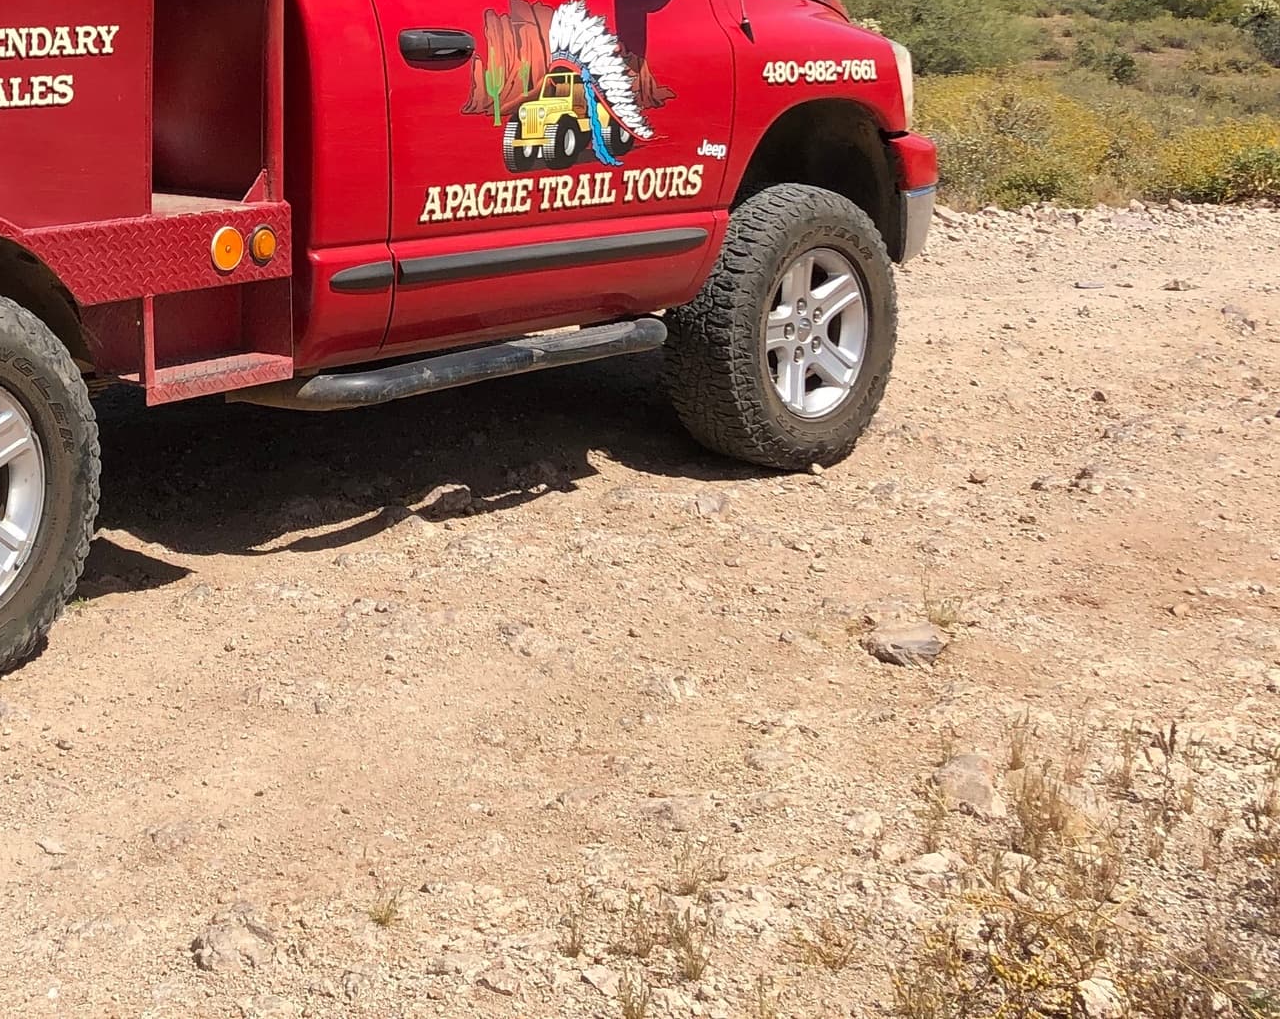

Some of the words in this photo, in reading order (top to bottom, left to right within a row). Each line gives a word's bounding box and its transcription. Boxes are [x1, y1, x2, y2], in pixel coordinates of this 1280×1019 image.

[761, 59, 878, 85] 480-982-7661
[697, 139, 727, 159] Jeep
[417, 178, 534, 225] APACHE
[536, 172, 619, 211] TRAIL
[623, 164, 705, 202] TOURS
